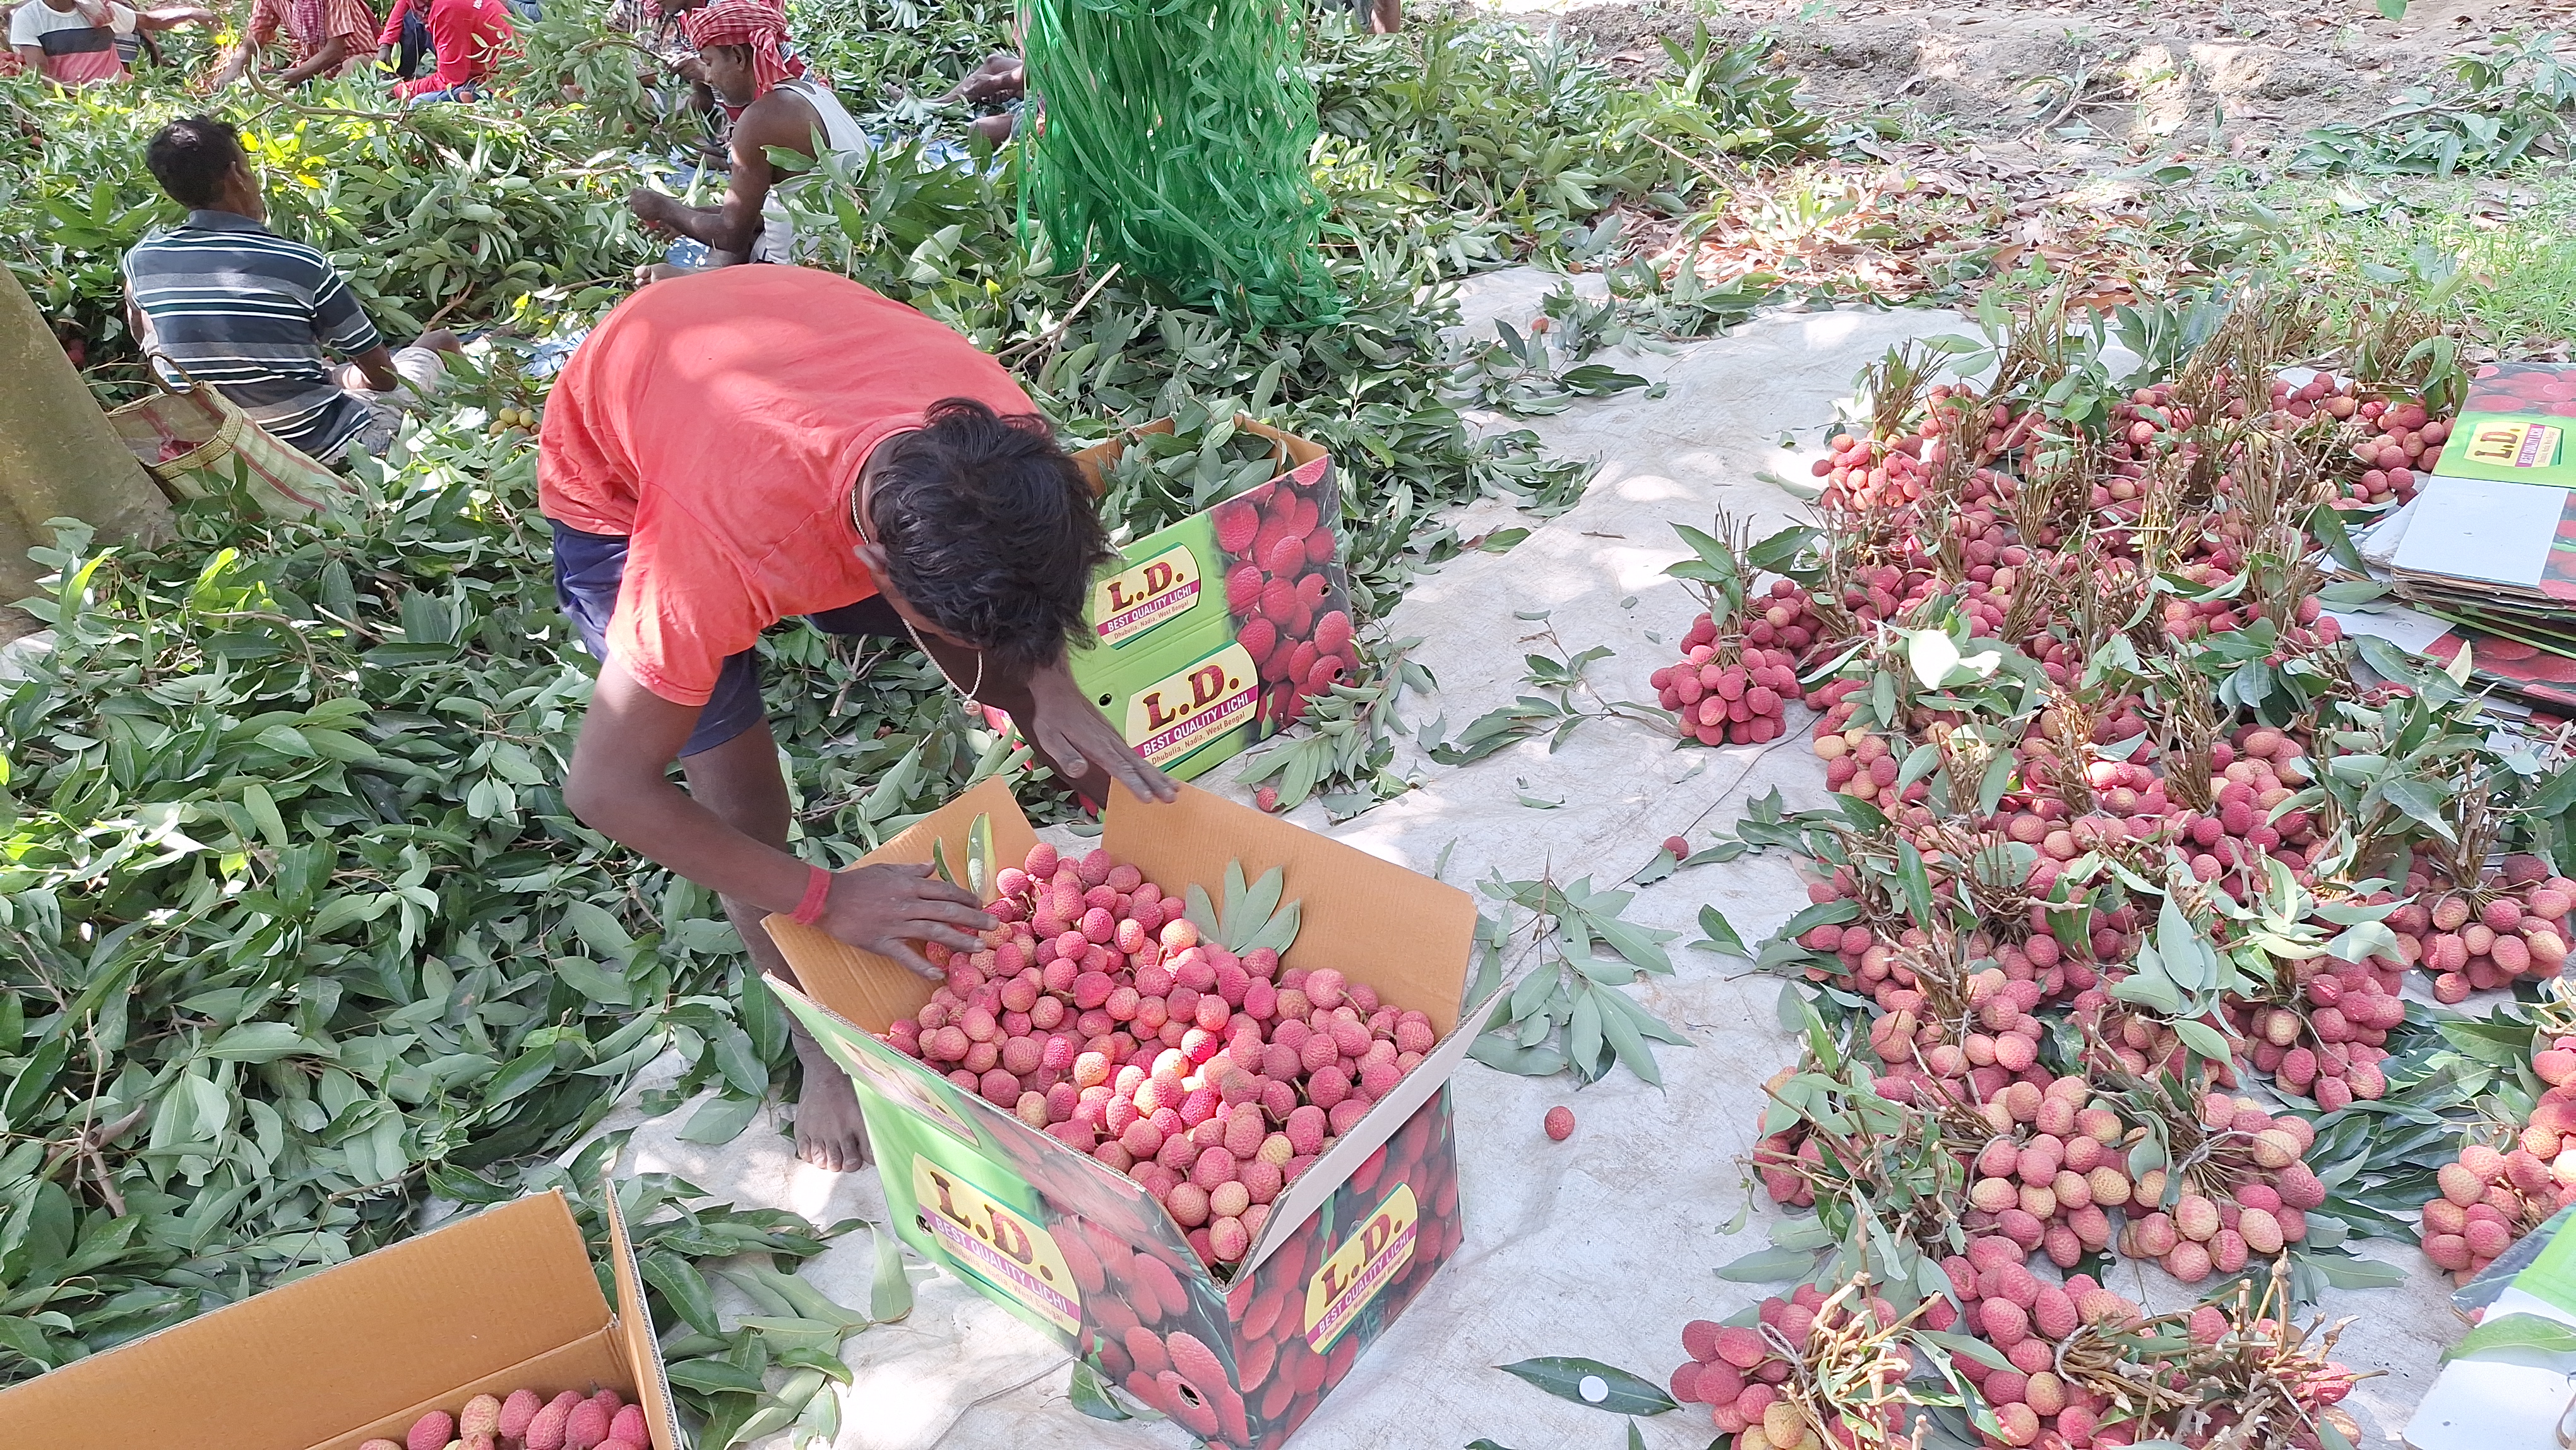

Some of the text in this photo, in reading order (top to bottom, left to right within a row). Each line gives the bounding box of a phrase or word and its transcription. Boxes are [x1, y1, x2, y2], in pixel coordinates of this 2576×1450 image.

[2474, 428, 2520, 458] L.D.
[2519, 453, 2534, 464] BEST
[1107, 562, 1183, 612] L.D.
[1107, 585, 1191, 632] BEST QUALITY LICHI
[1140, 616, 1157, 626] Nadia,
[1158, 608, 1171, 619] West
[1172, 600, 1188, 611] Bengal
[1143, 664, 1239, 731] L.D.
[1143, 693, 1248, 756] BEST QUALITY LICHI
[1152, 711, 1245, 765] Dhubulia, Nadia, West Bengal
[929, 1171, 1053, 1282] L.D.
[935, 1216, 1068, 1313] BEST QUALITY LICHI
[1320, 1230, 1409, 1334] BEST QUALITY LICHI
[1321, 1214, 1402, 1309] L.D.
